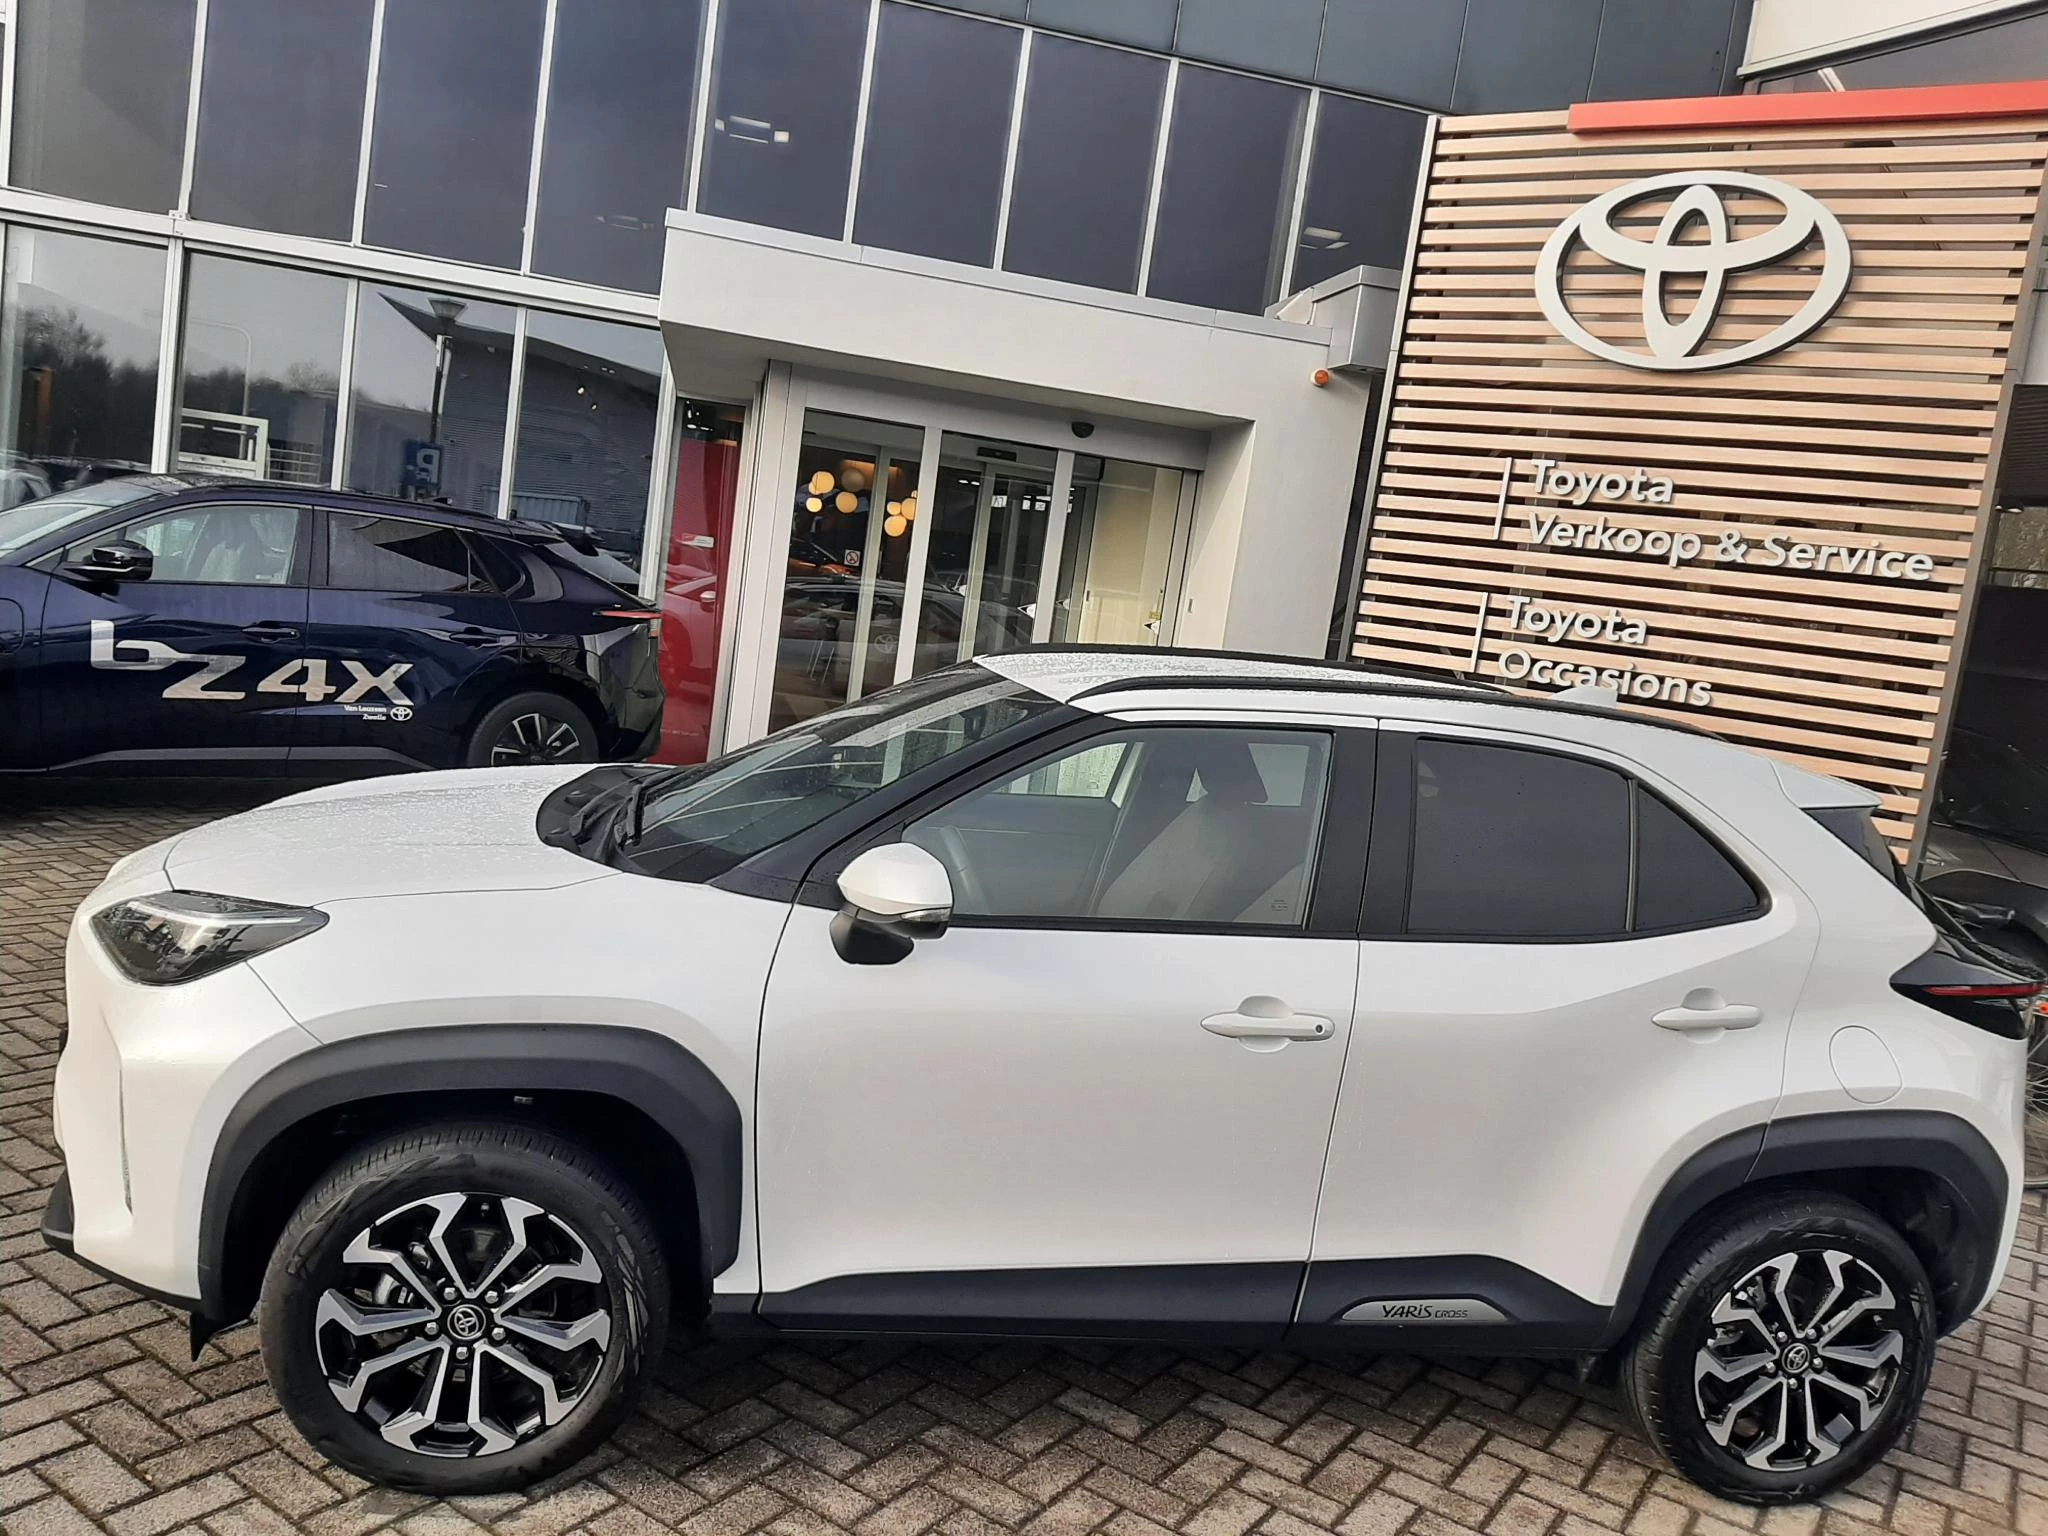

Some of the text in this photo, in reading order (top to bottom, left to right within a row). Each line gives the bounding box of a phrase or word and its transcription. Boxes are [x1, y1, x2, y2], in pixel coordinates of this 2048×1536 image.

[1531, 459, 1674, 505] Toyota
[1528, 512, 1935, 581] Verkoop & Service
[1507, 595, 1648, 645] Toyota
[1499, 648, 1713, 707] Occasions
